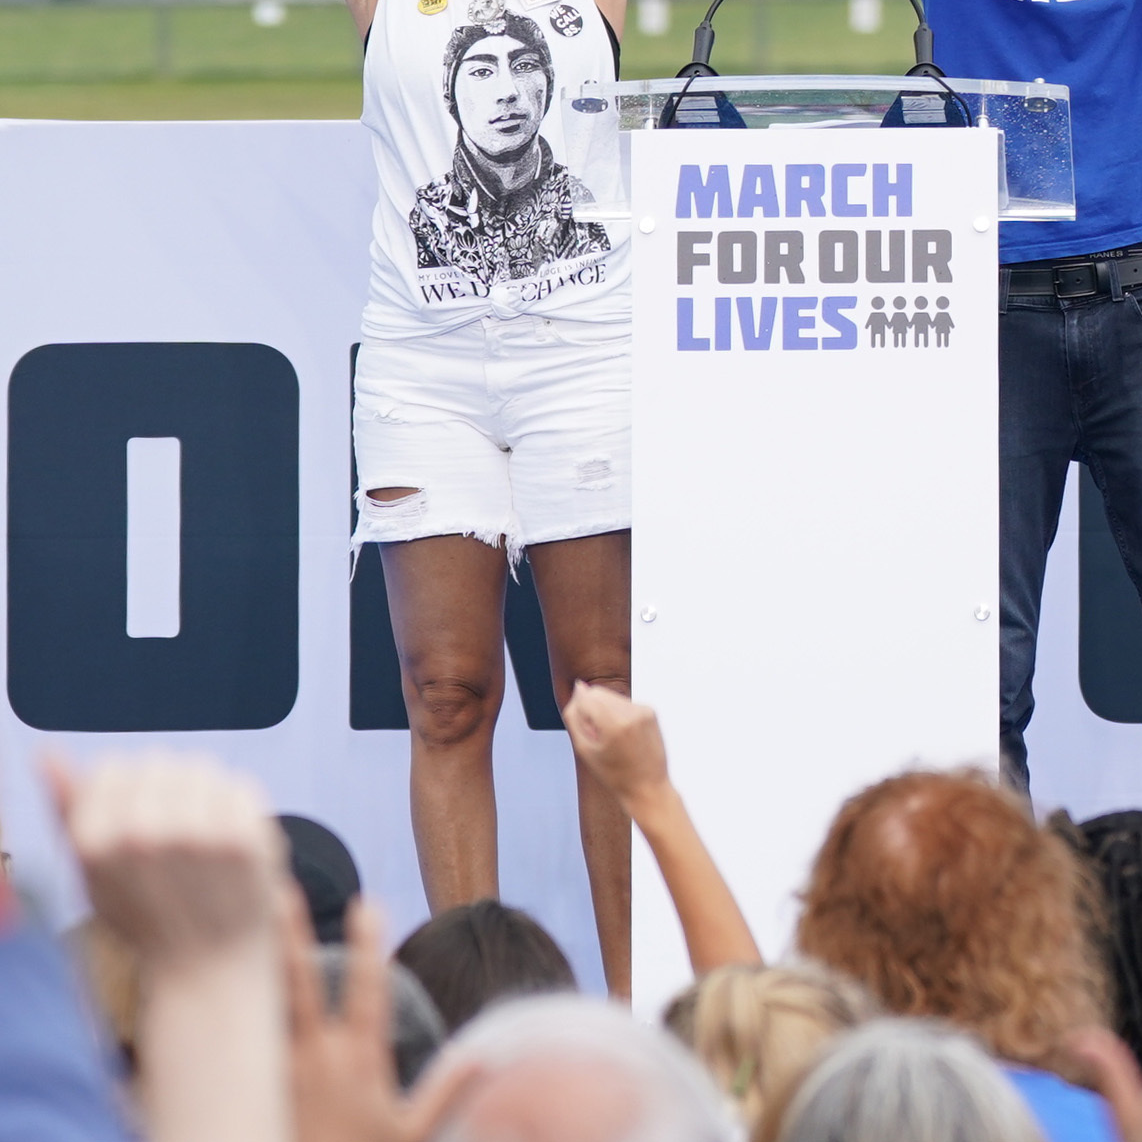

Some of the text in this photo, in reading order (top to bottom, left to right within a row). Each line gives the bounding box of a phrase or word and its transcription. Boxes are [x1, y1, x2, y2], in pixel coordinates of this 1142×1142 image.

[550, 5, 566, 19] WE
[556, 9, 581, 28] CALL
[675, 163, 913, 218] MARCH
[676, 229, 953, 285] FOR OUR
[418, 273, 430, 282] MY
[435, 271, 459, 280] LOVE
[420, 281, 466, 304] WE
[676, 296, 858, 351] LIVES
